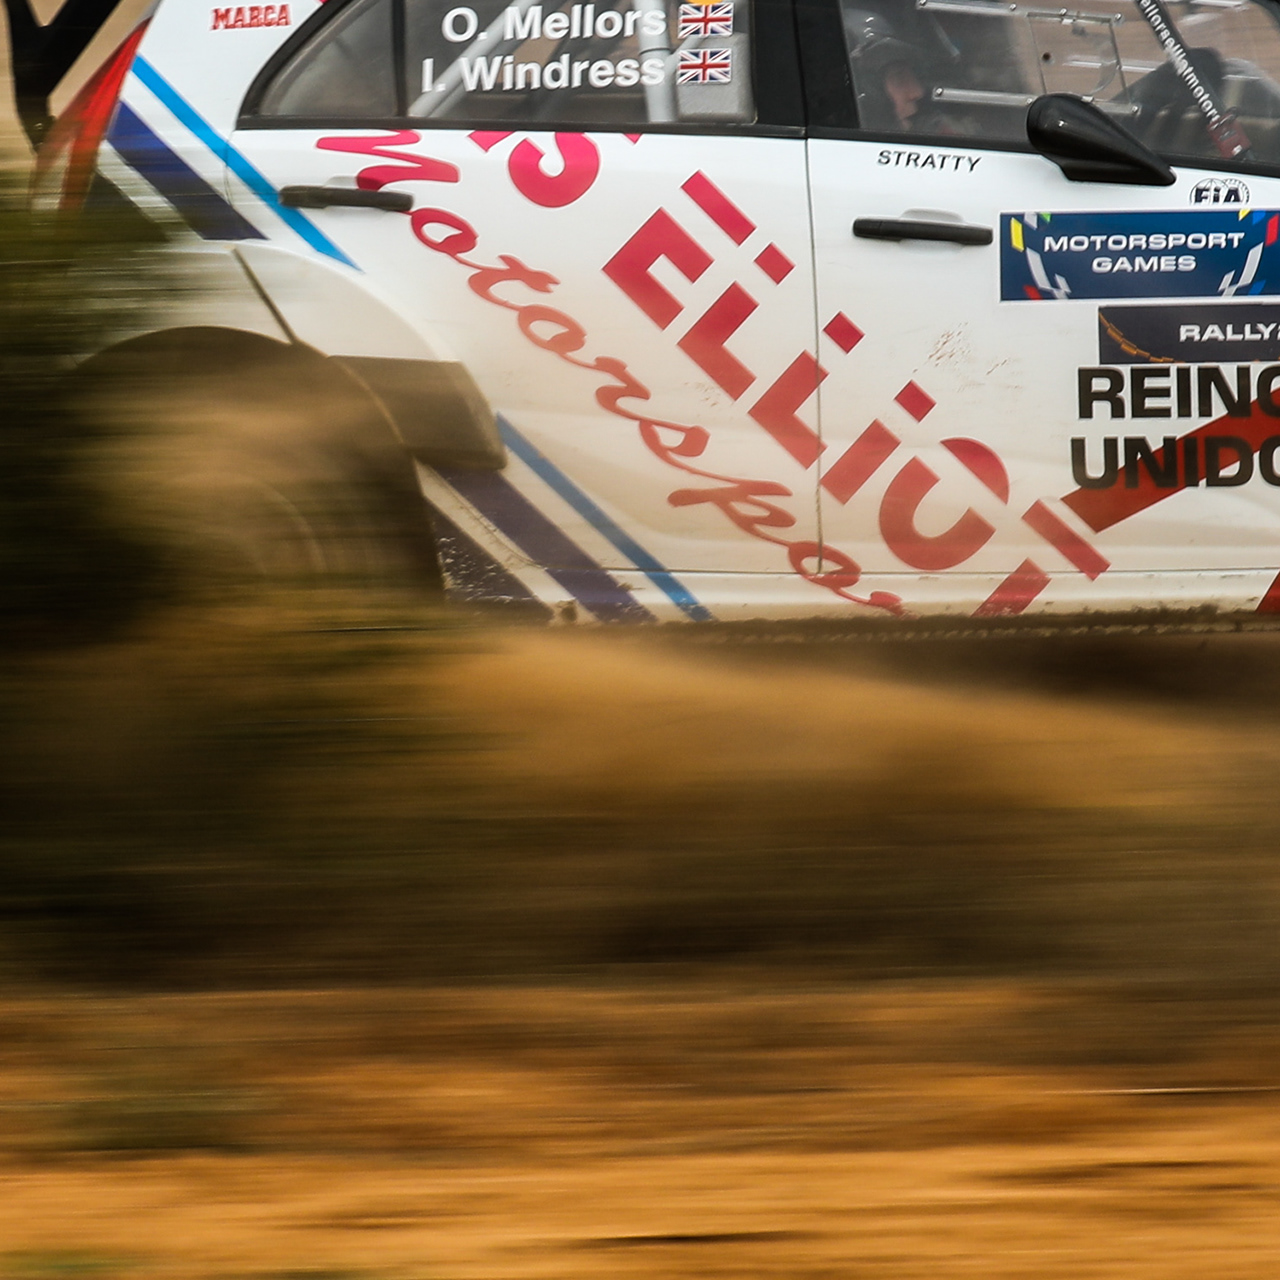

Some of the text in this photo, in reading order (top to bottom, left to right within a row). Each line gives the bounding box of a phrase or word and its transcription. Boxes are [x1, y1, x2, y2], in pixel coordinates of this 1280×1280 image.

[210, 4, 291, 30] MARCA
[441, 4, 667, 42] O. Mellors
[460, 53, 666, 91] Windress
[877, 150, 982, 172] STRATTY
[1043, 232, 1245, 252] MOTORSPORT
[1091, 255, 1197, 274] GAMES
